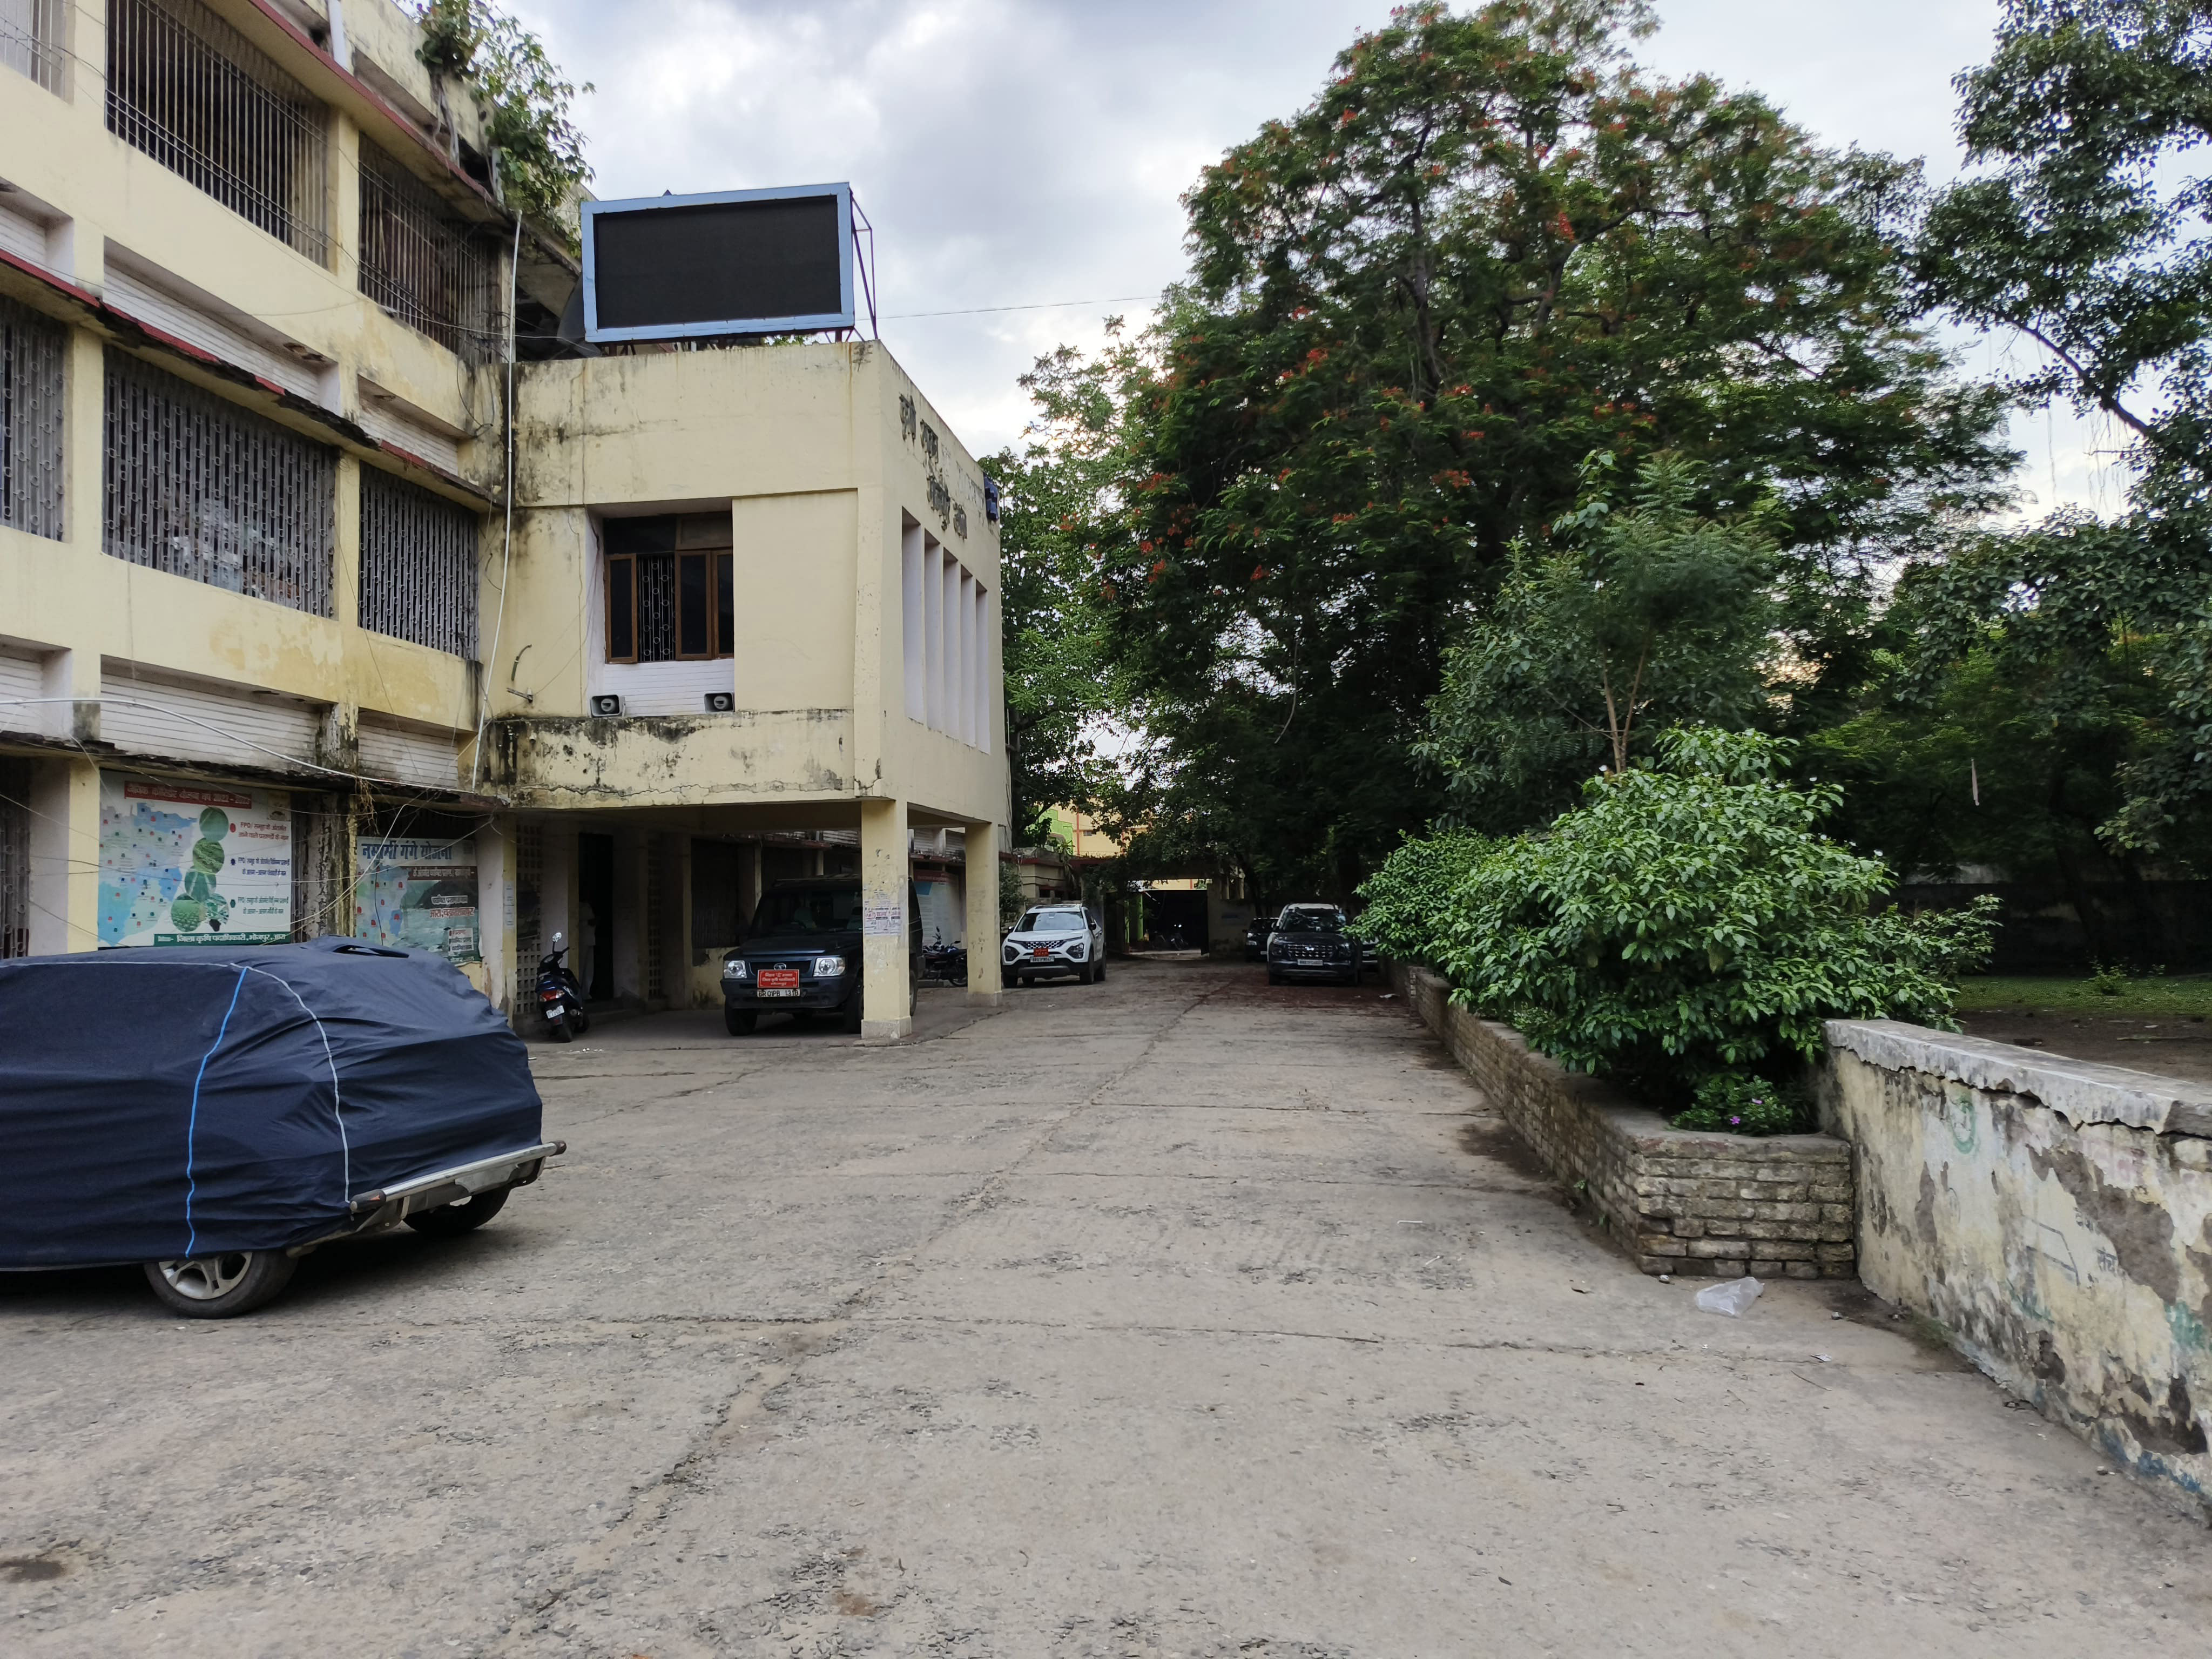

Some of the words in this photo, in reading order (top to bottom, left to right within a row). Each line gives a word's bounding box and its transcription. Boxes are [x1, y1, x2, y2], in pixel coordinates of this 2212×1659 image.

[401, 840, 418, 860] गंगे
[177, 934, 195, 942] जिला
[195, 934, 211, 943] कृषि
